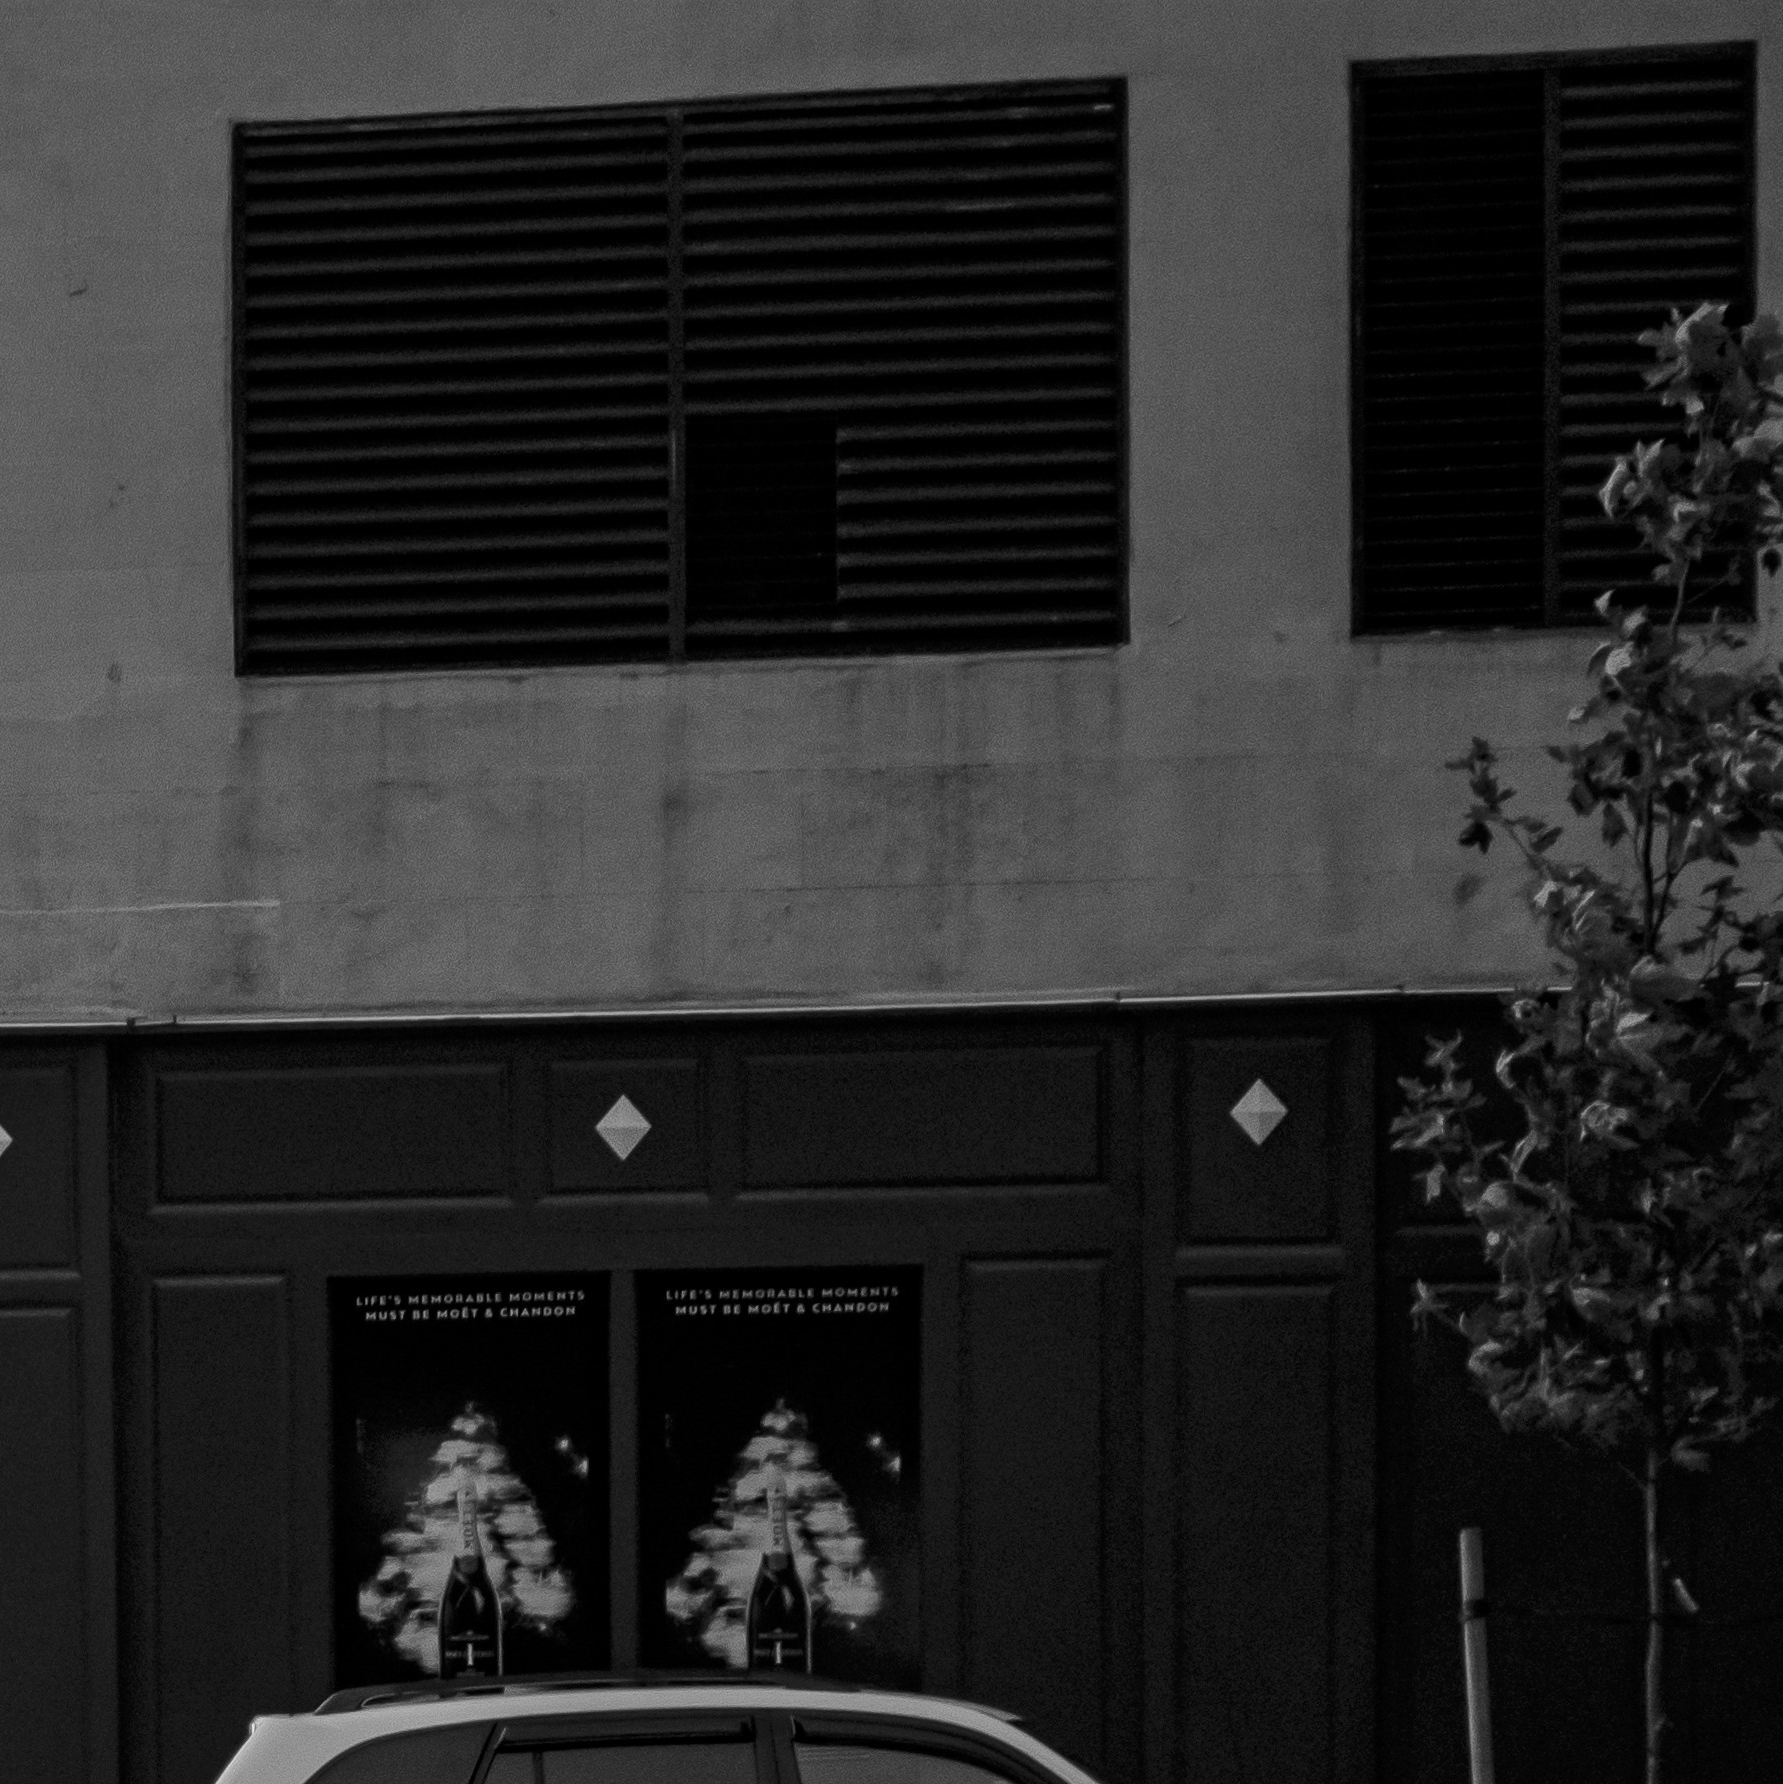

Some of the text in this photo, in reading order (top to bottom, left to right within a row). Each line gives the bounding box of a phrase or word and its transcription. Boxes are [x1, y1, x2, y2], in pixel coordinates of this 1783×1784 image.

[356, 1289, 585, 1306] LIFE'S MEMORABLE MOMENTS
[665, 1285, 899, 1301] LIFE'S MEMORABLE MOMENTS
[365, 1309, 407, 1321] MUST
[412, 1309, 430, 1320] BE
[484, 1308, 494, 1318] &
[499, 1306, 576, 1318] CHANDON
[675, 1304, 717, 1316] MUST
[722, 1304, 741, 1315] BE
[796, 1303, 806, 1314] &
[812, 1302, 890, 1314] CHANDON
